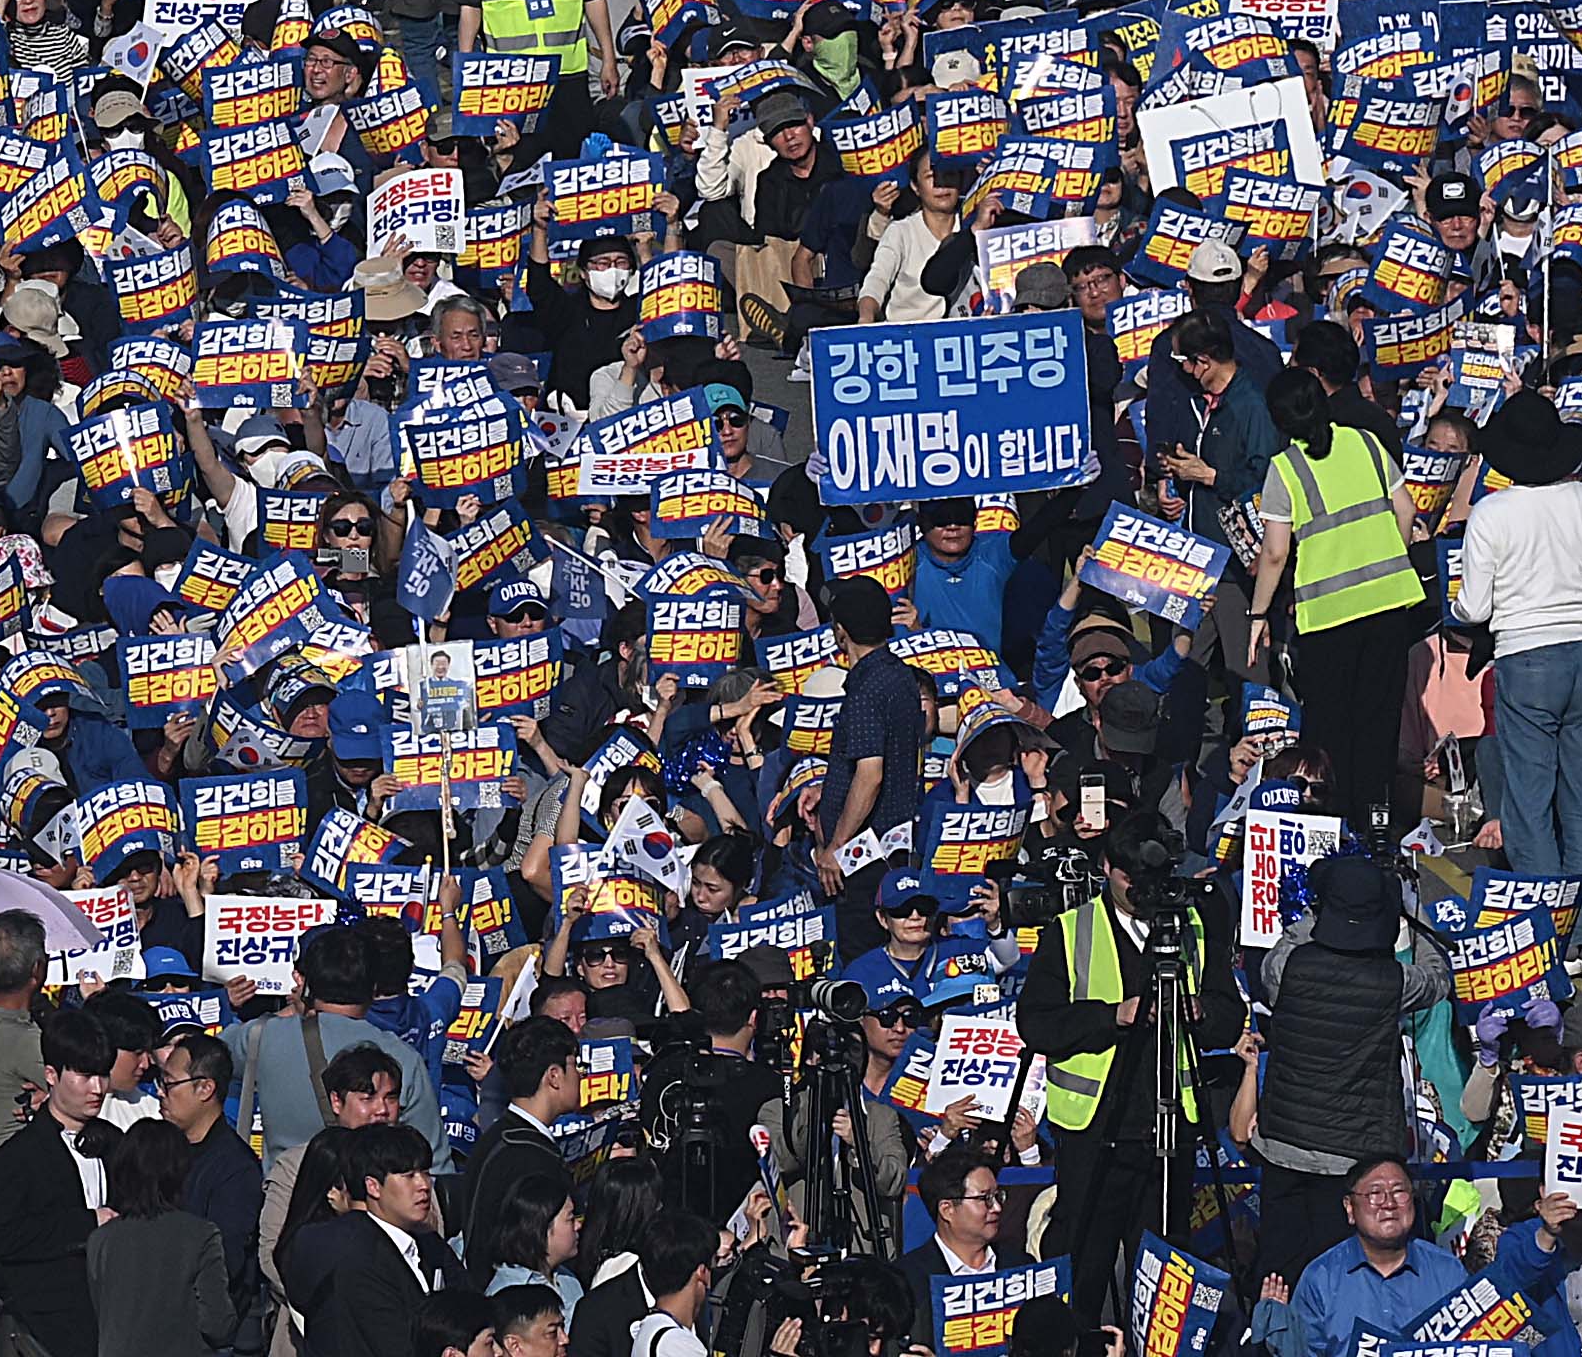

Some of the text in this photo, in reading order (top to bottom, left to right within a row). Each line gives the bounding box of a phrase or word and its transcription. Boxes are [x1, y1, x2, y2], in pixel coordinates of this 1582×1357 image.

[376, 172, 453, 212] 국정농단
[373, 198, 460, 236] 진상규명!
[829, 326, 1069, 404] 강한 민주당
[828, 410, 1083, 492] 이재명이 합니다
[194, 778, 299, 818] 김건희를
[196, 808, 307, 848] 특검하라!
